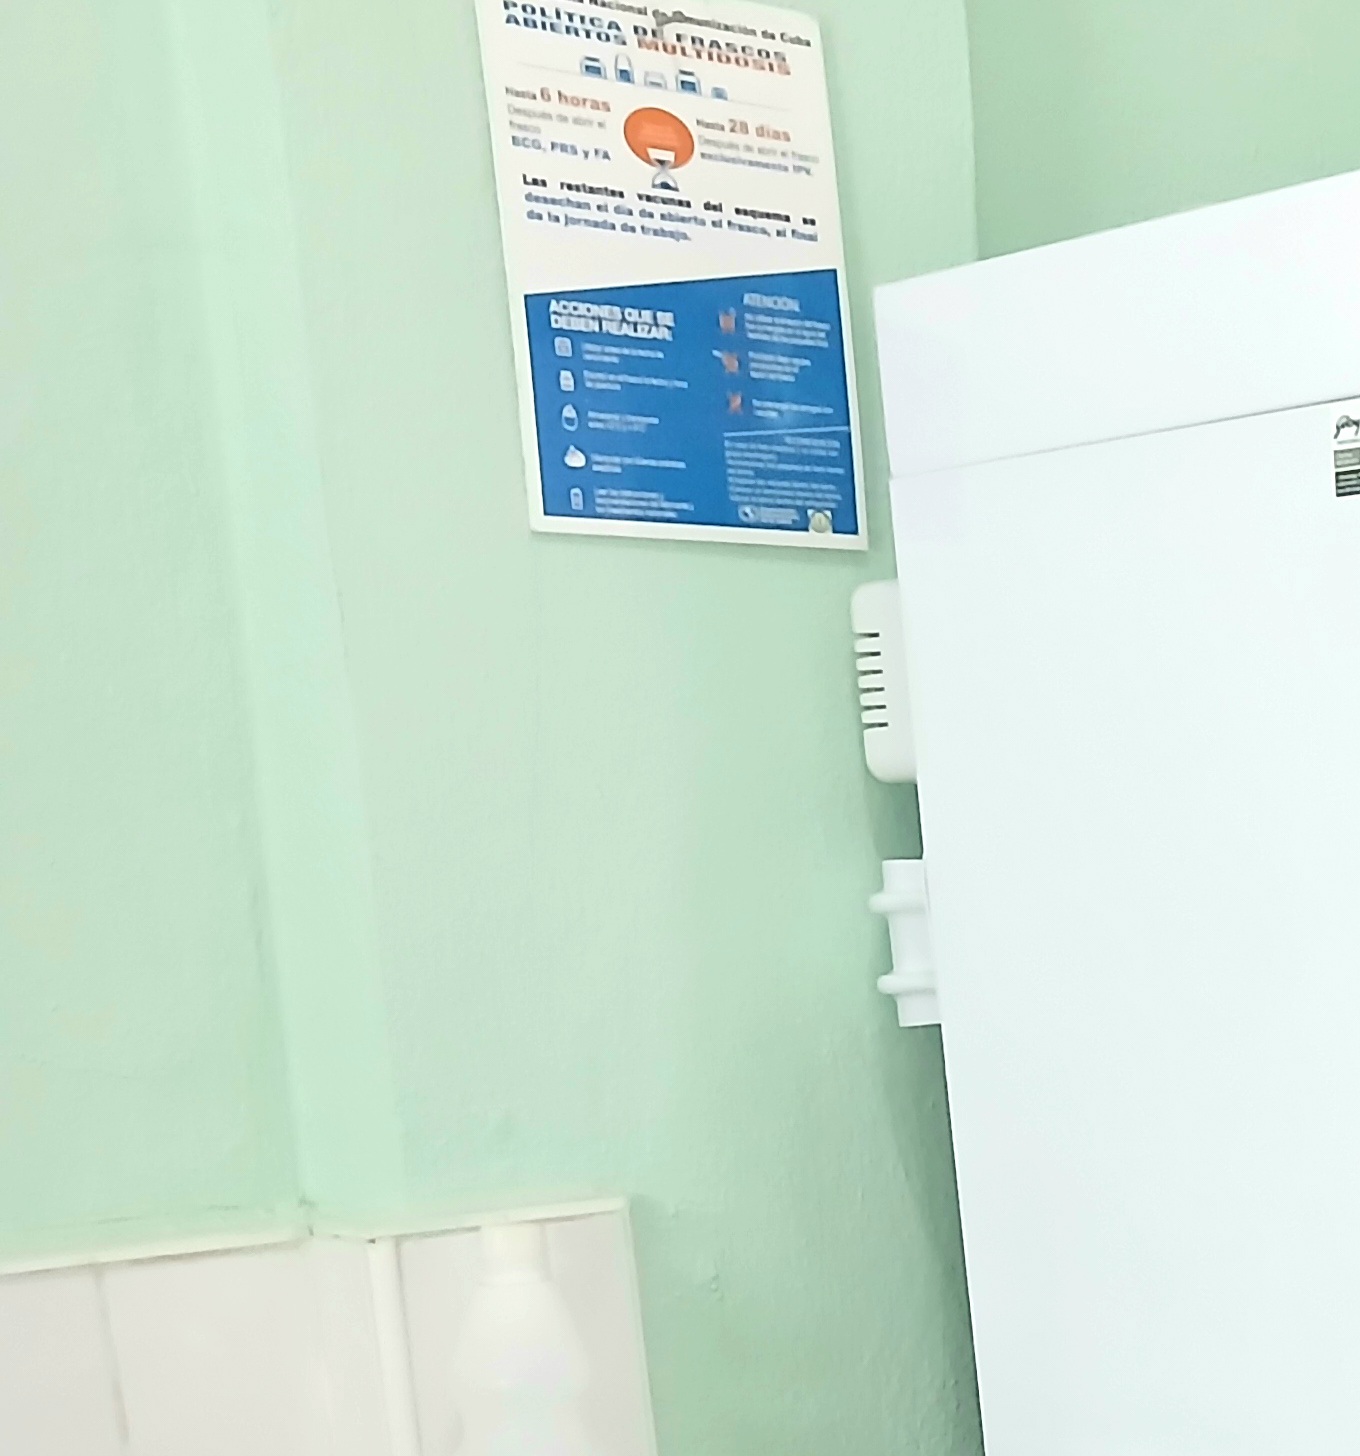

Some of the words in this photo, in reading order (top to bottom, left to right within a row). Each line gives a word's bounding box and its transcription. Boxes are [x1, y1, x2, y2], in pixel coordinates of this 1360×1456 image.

[505, 14, 628, 46] ABIERTOS
[637, 37, 791, 76] MULTIDOSIS
[675, 32, 787, 63] FRASCOS
[540, 86, 552, 103] 6
[557, 89, 611, 113] horas
[728, 118, 749, 136] 28
[522, 172, 548, 188] Las
[560, 180, 625, 200] restantes
[637, 192, 692, 209] vacunas
[703, 200, 723, 214] del
[734, 206, 792, 224] esquema
[549, 298, 622, 321] ACCIONES
